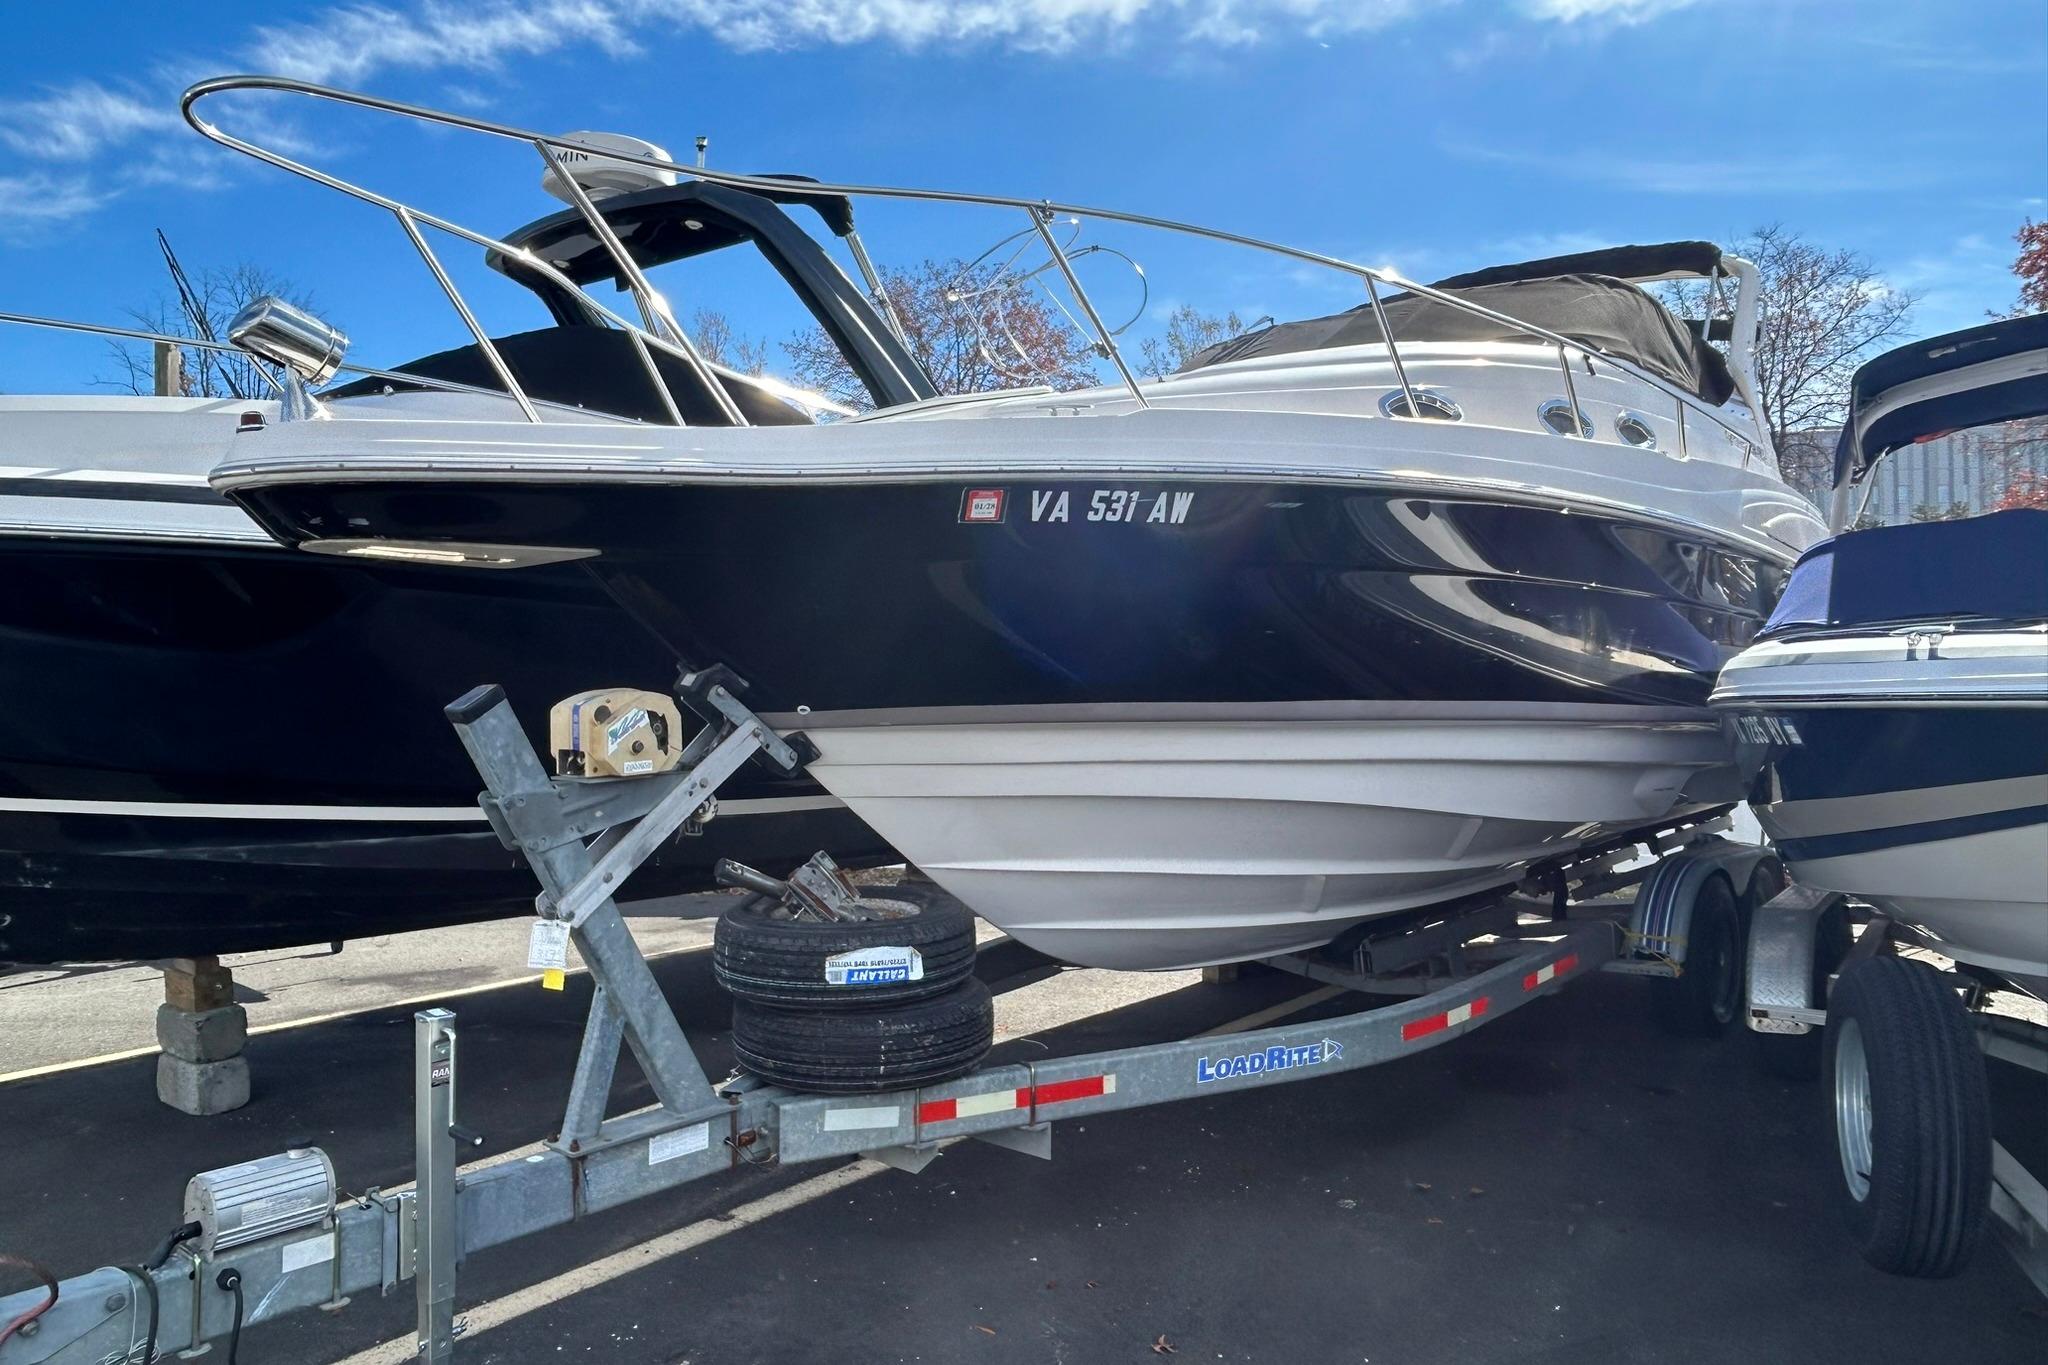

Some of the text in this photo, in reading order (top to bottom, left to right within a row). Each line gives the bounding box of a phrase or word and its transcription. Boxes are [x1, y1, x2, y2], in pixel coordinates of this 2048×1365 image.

[1031, 490, 1194, 524] VA 531 AW
